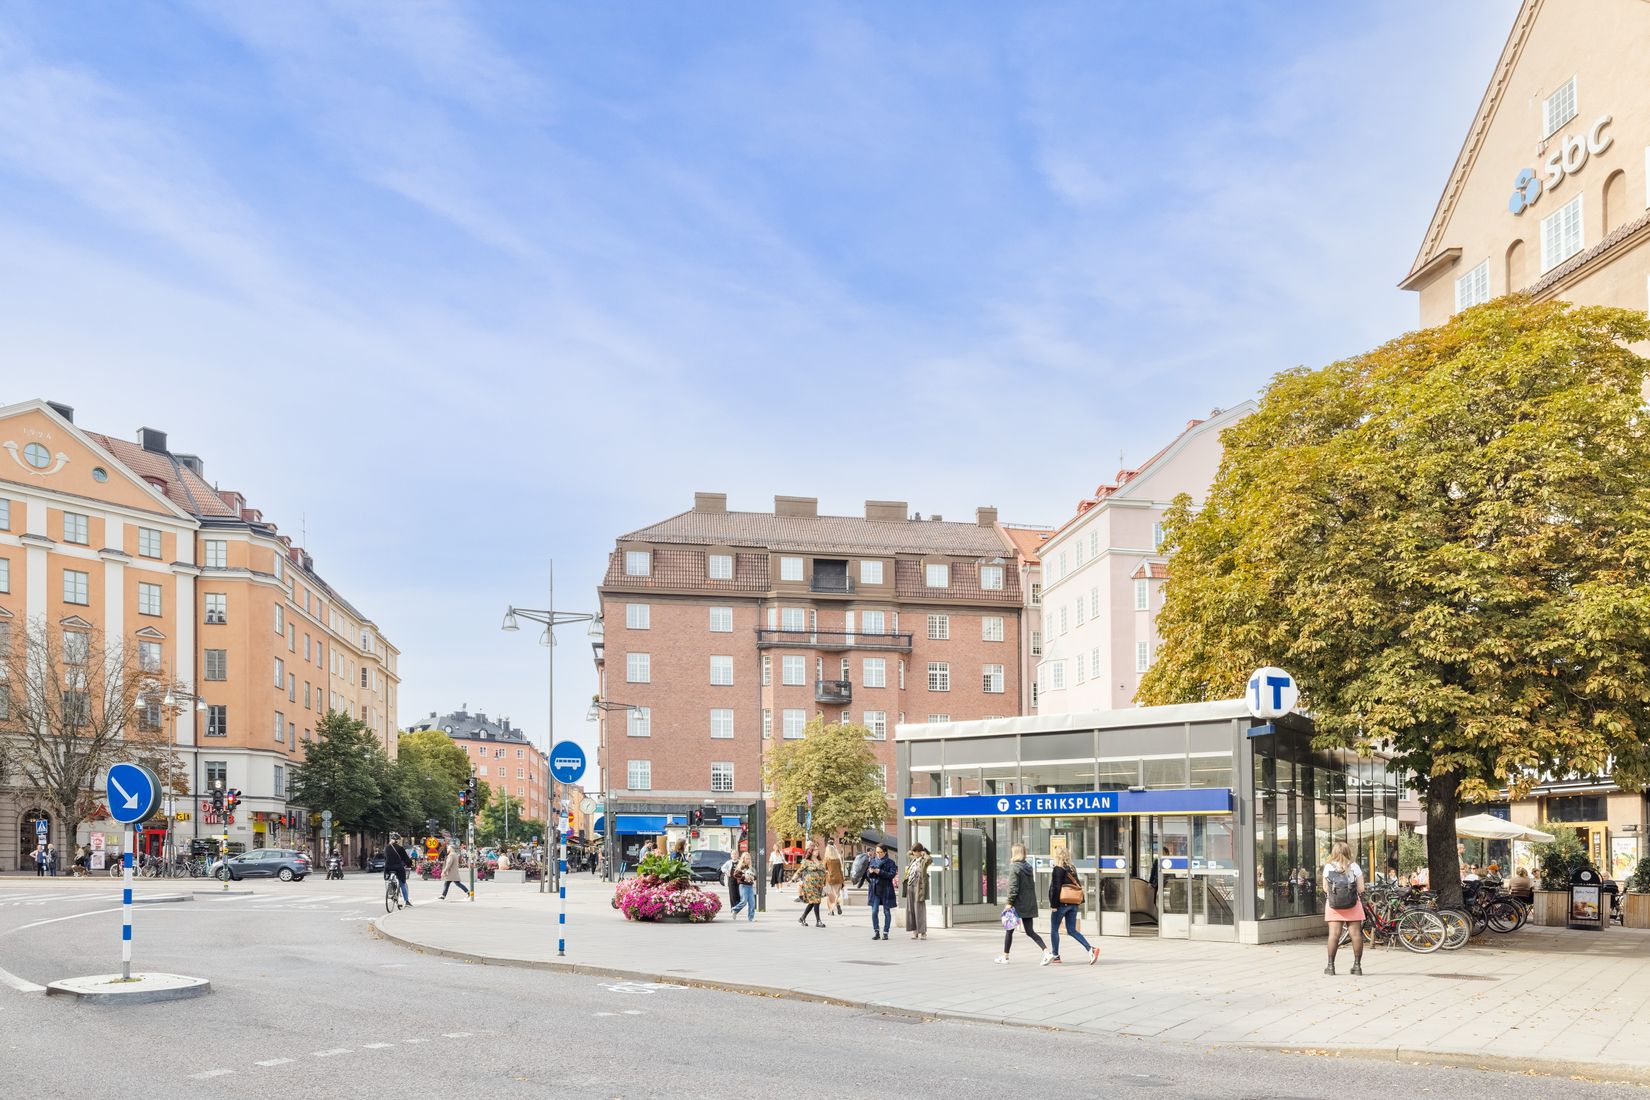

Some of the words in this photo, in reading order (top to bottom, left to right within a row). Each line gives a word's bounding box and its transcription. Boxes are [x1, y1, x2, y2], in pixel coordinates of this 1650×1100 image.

[1544, 114, 1614, 192] sbc
[1266, 676, 1290, 710] T
[1015, 799, 1032, 811] S:T
[1036, 797, 1111, 810] ERIKSPLAN
